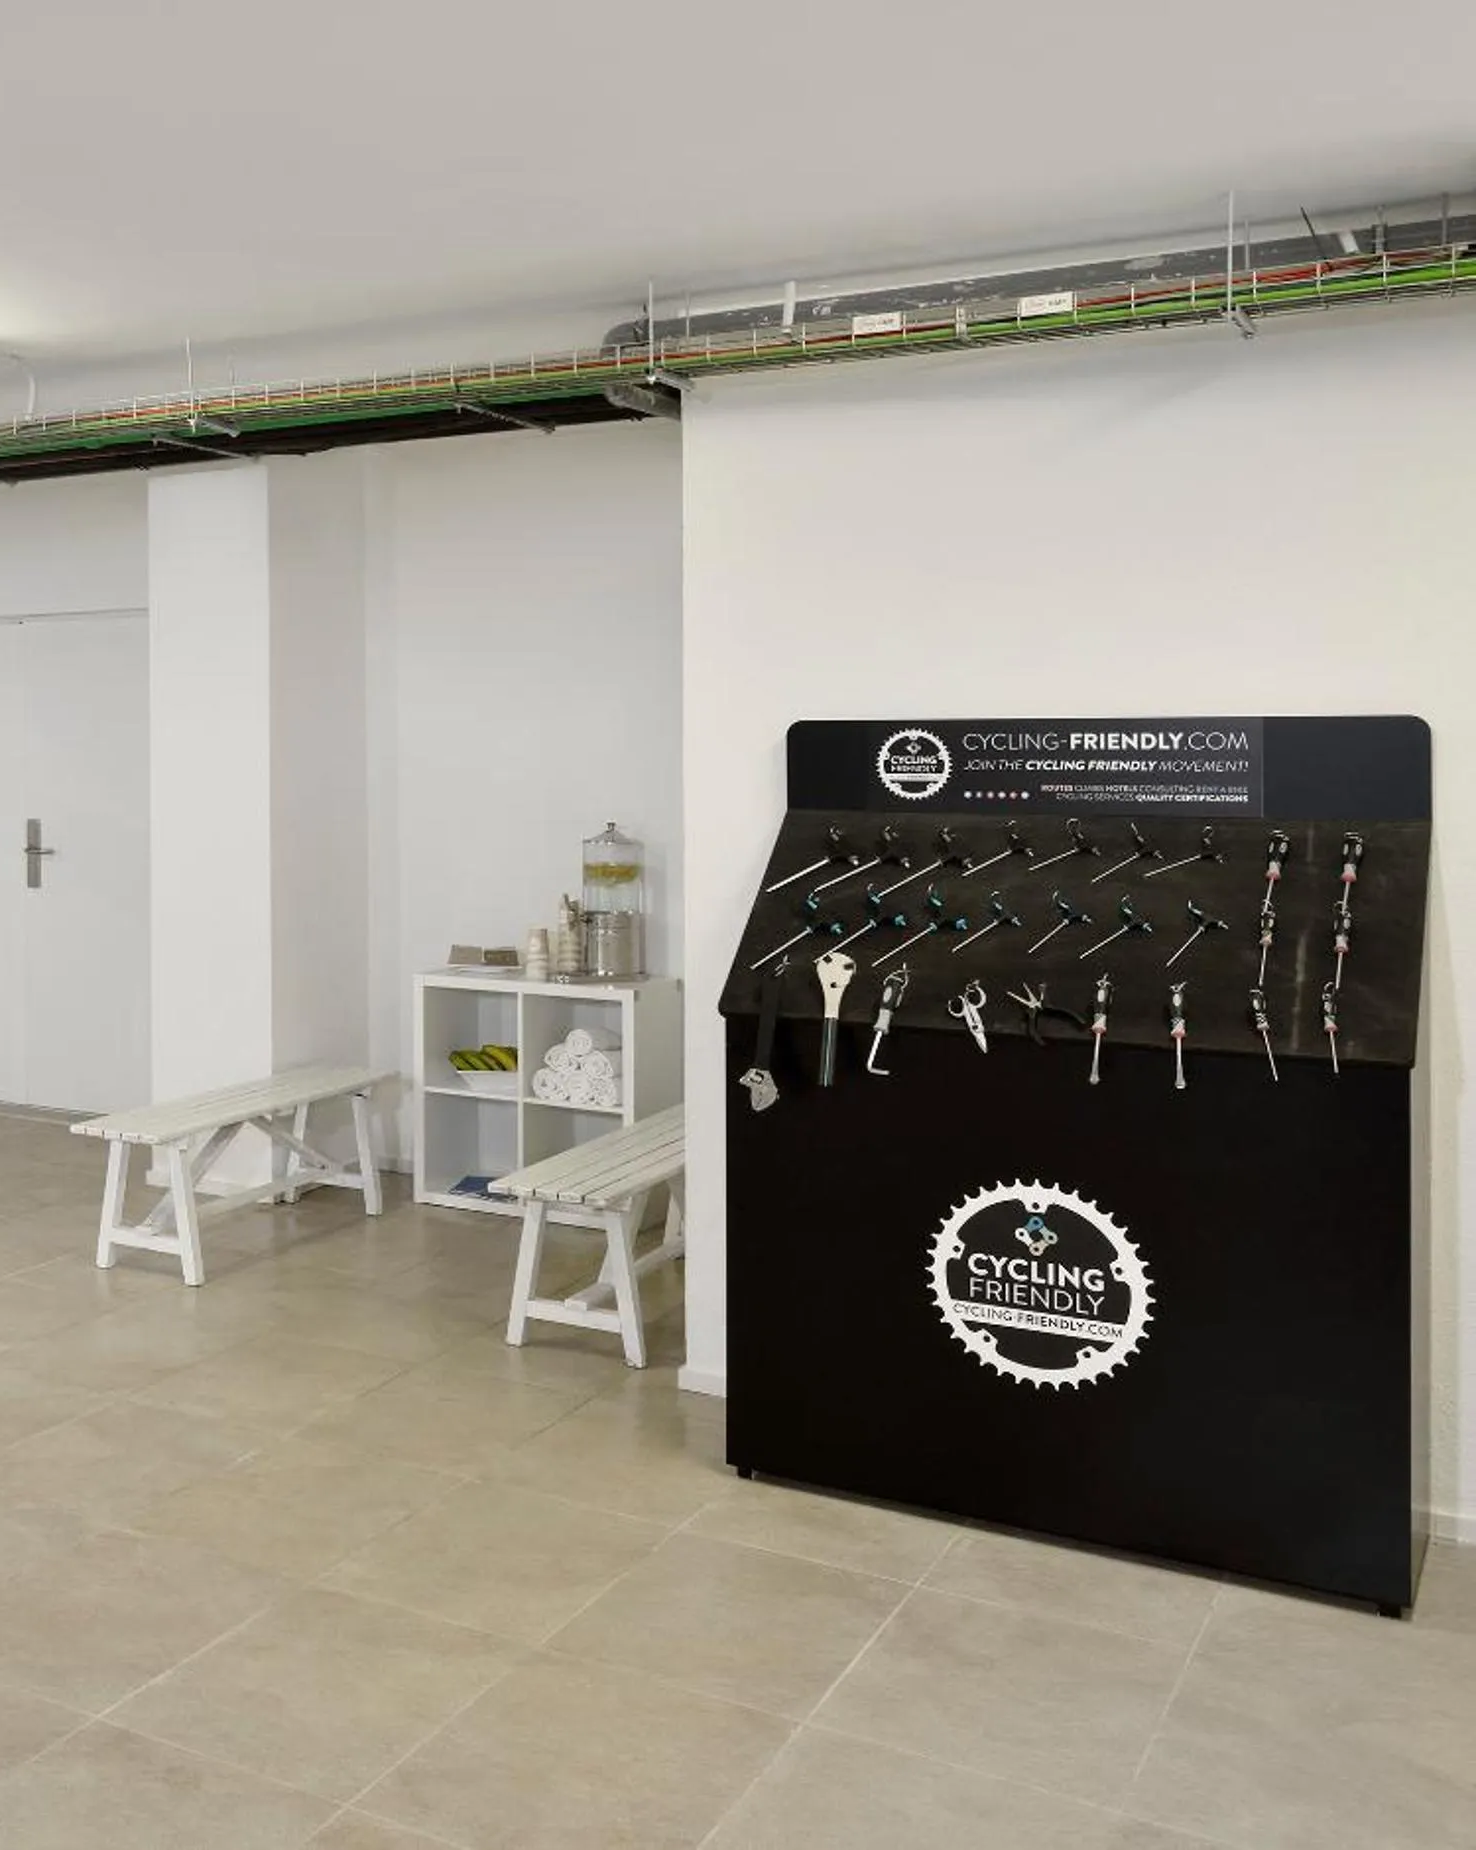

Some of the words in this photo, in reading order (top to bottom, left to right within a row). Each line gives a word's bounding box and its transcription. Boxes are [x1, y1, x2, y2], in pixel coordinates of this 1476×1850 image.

[962, 732, 1249, 751] CYCLING-FRIENDLY.COM
[891, 755, 938, 765] CYCLING
[964, 759, 996, 771] JOIN
[998, 759, 1024, 771] THE
[1025, 760, 1085, 771] CYCLING
[1087, 760, 1157, 772] FRIENDLY
[1158, 760, 1249, 773] MOVEMENT!
[967, 1253, 1105, 1292] CYCLING
[969, 1277, 1105, 1316] FRIENDLY
